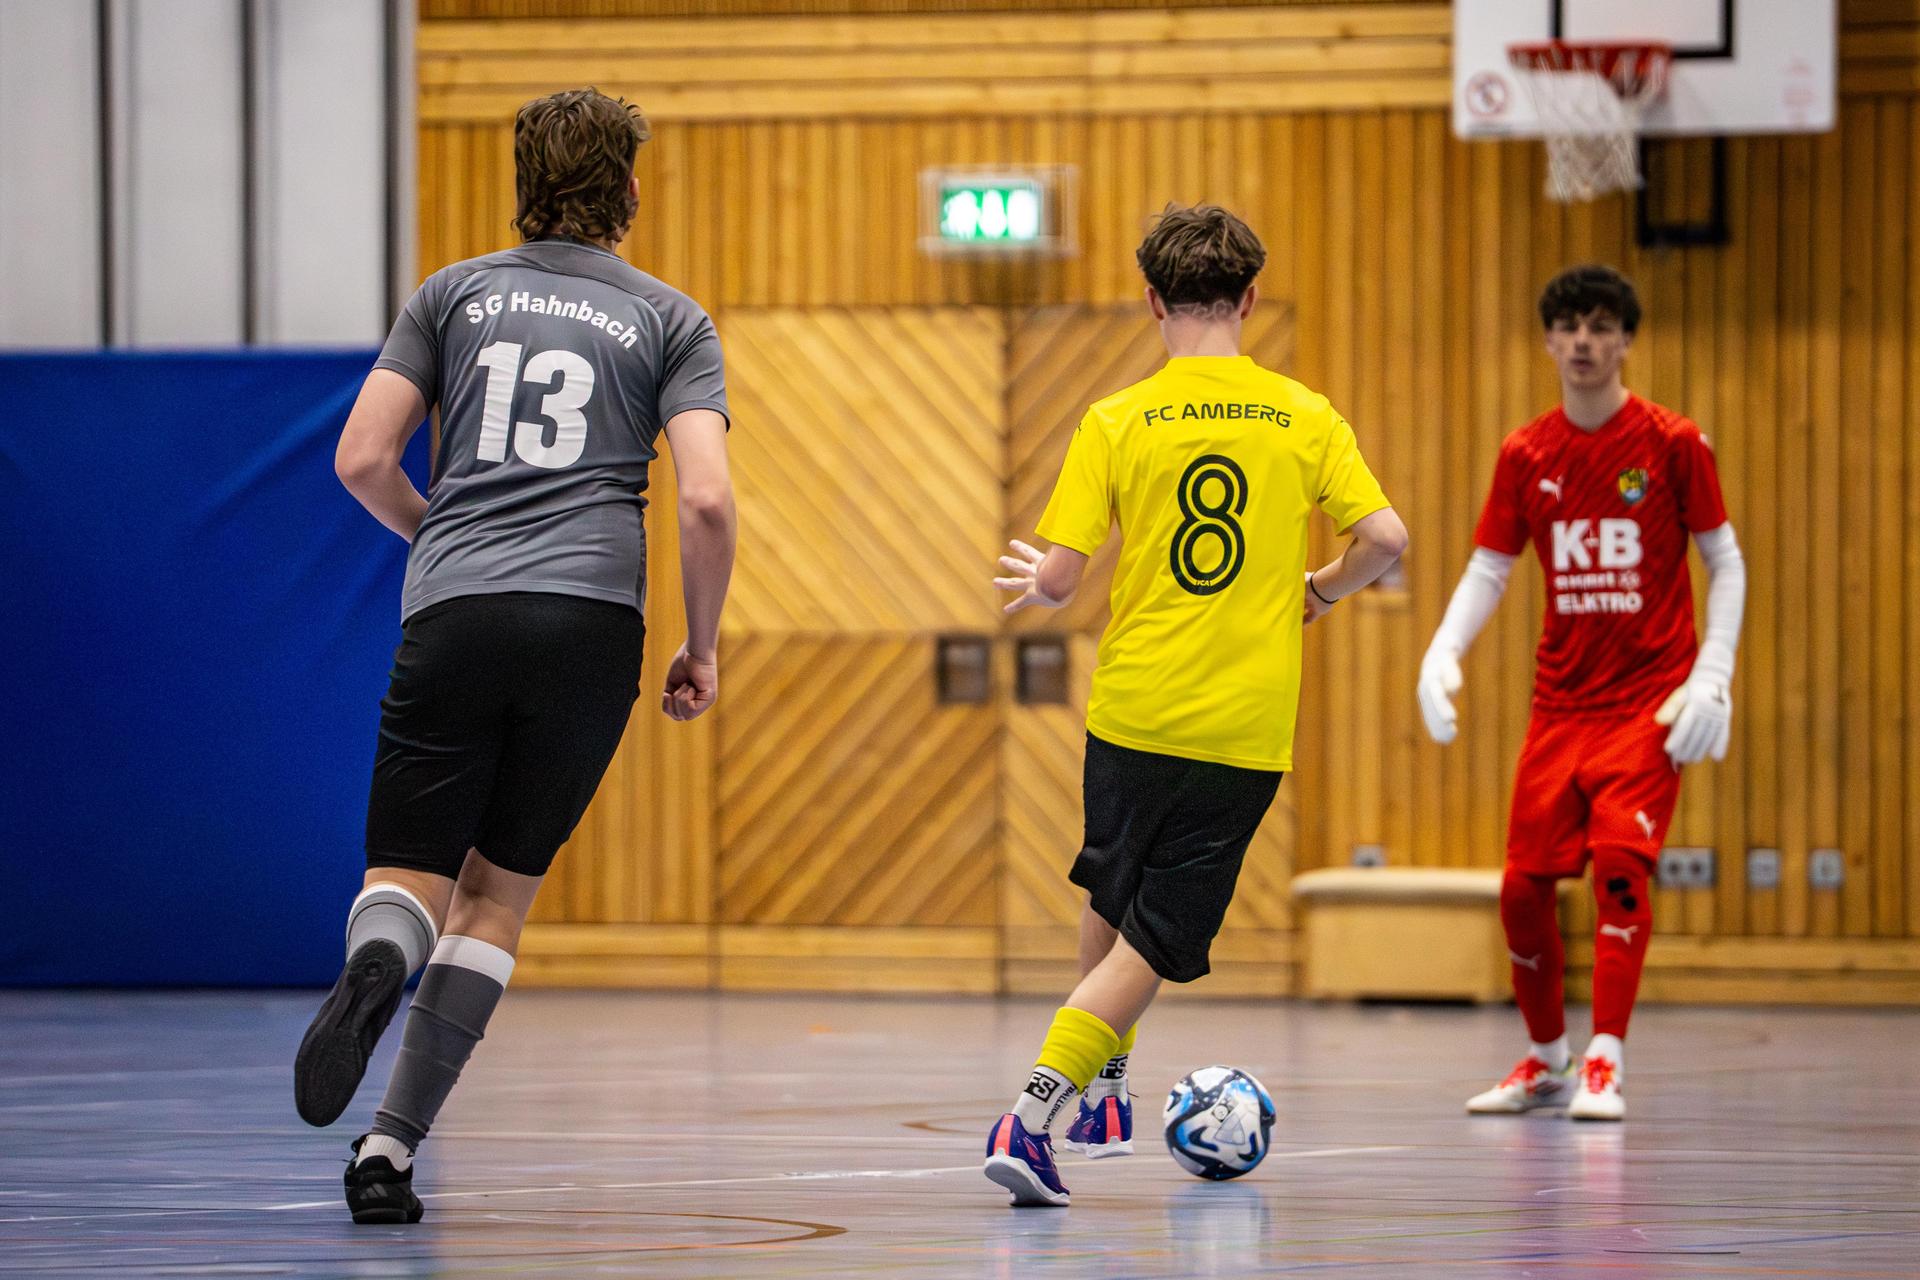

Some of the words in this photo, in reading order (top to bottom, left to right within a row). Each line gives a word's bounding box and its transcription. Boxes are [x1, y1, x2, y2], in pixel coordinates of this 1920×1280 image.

[465, 294, 503, 324] SG
[510, 291, 638, 349] Hahnbach
[476, 340, 596, 469] 13
[1143, 405, 1176, 427] FC
[1181, 403, 1292, 428] AMBERG
[1169, 453, 1249, 596] 8
[1025, 1072, 1057, 1100] FS
